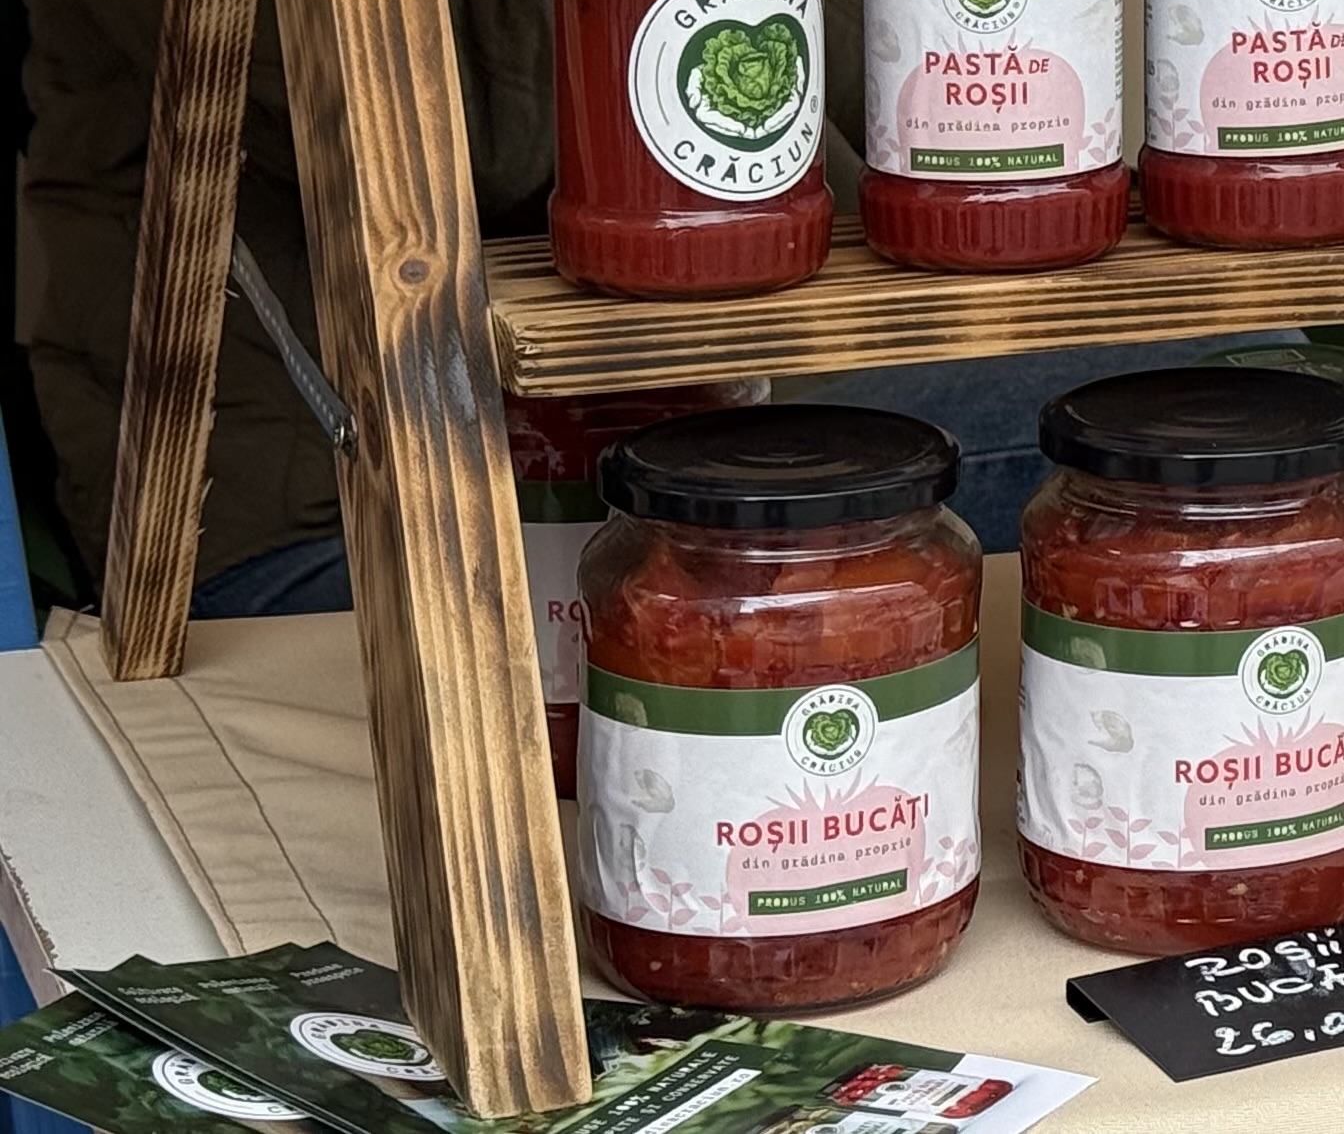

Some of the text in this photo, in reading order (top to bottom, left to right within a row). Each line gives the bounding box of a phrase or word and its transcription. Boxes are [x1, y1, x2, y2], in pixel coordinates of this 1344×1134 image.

[1231, 21, 1327, 55] PASTĂ
[925, 44, 1050, 76] PASTĂ DE
[1253, 56, 1331, 90] ROȘII
[945, 81, 1029, 114] ROȘII
[1211, 97, 1236, 109] din
[1246, 95, 1307, 112] grădina
[905, 116, 1070, 133] din grădina proprie
[1276, 130, 1308, 143] 100%
[673, 122, 814, 184] CRĂCIUN
[968, 156, 1001, 168] 100%
[1007, 153, 1059, 166] NATURAL
[1174, 755, 1262, 790] ROȘII
[1198, 792, 1226, 807] din
[1235, 788, 1297, 808] grădina
[716, 793, 930, 854] ROȘII BUCĂȚI
[1212, 813, 1344, 843] PRODUS 100% NATURAL
[741, 838, 912, 872] din grădina proprie
[756, 879, 903, 908] PRODUS 100% NATURAL
[607, 1050, 718, 1116] 100% NATURALE
[661, 1053, 741, 1102] CONSERVATE
